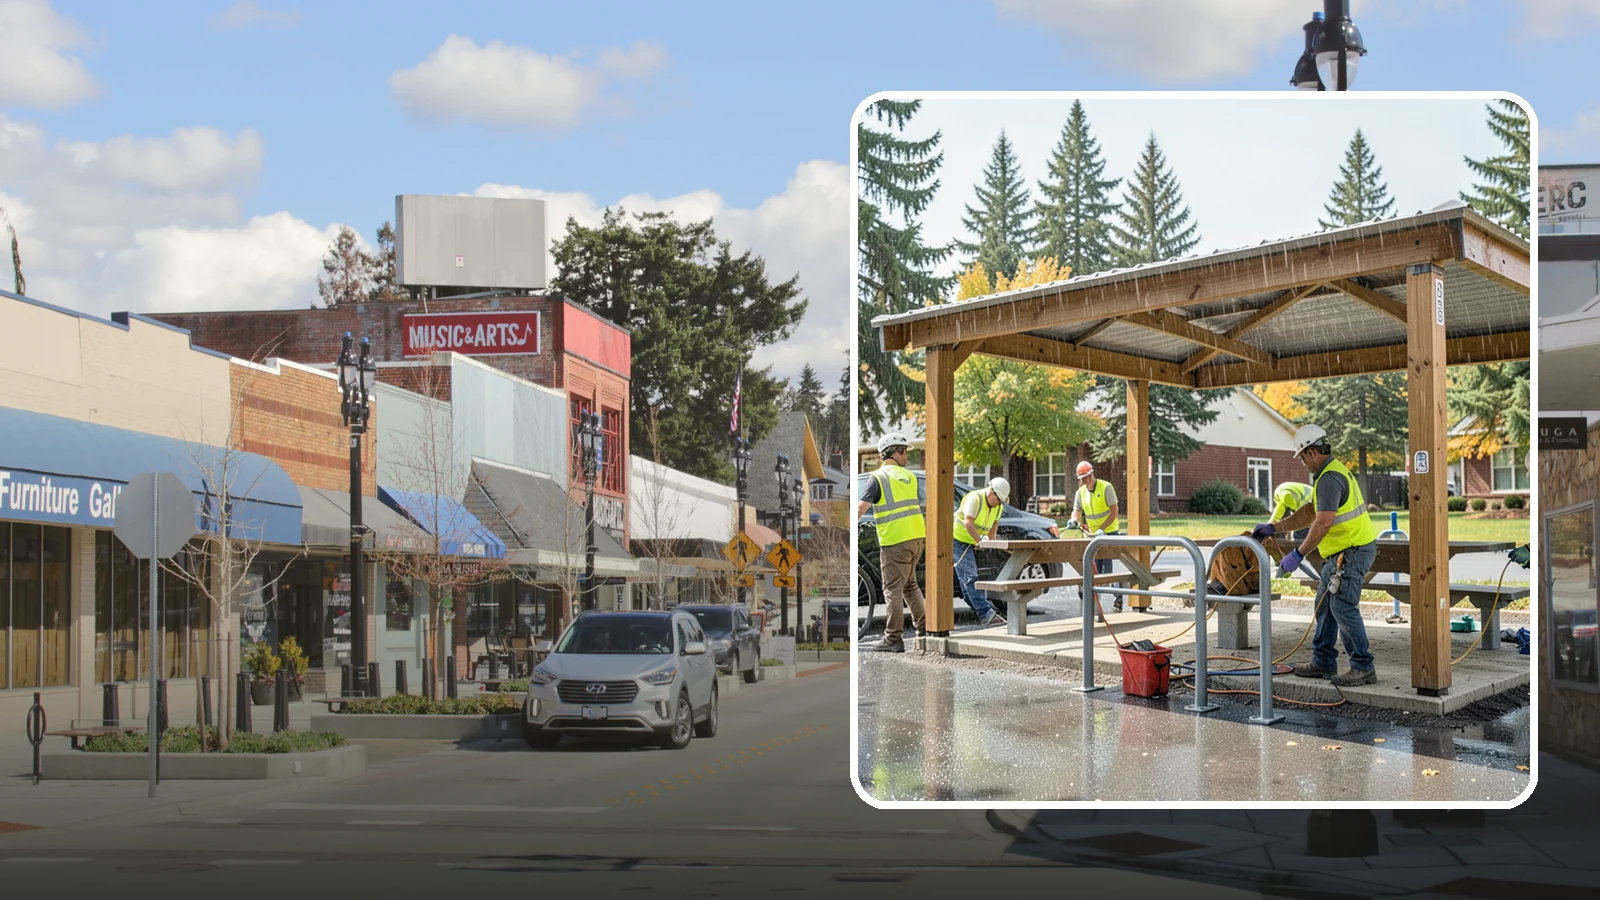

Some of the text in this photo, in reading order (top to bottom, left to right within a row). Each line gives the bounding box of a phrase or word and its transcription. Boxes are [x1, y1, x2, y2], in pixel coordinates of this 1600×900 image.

[409, 323, 519, 349] MUSIC&ARTS
[0, 472, 121, 519] Furniture Gal
